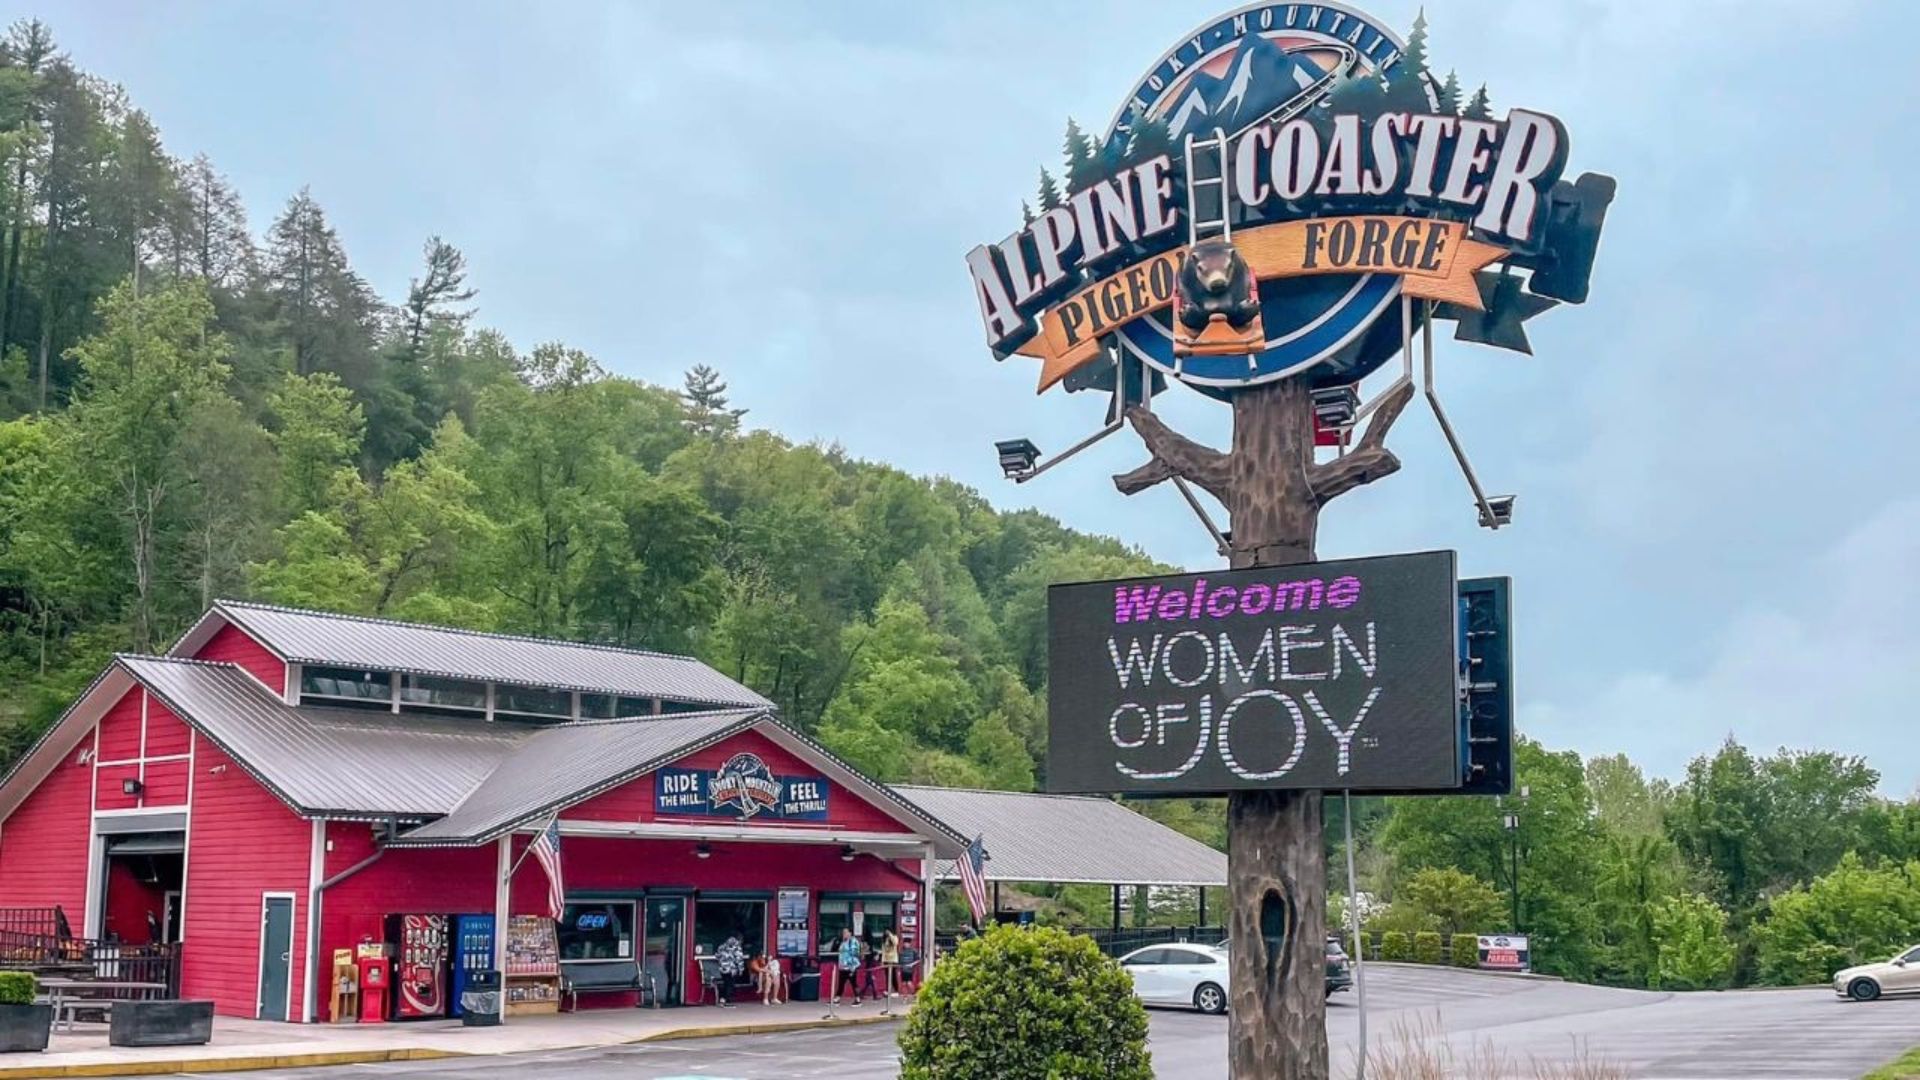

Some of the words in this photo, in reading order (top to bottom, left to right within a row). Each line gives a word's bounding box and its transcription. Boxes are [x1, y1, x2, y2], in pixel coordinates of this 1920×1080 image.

[1233, 5, 1401, 71] MOUNTAIN
[965, 153, 1180, 348] ALPINE
[1235, 108, 1559, 241] COASTER
[1056, 251, 1186, 347] PIGEO
[1301, 218, 1450, 271] FORGE
[1114, 575, 1361, 624] Welcome
[1107, 621, 1377, 689] WOMEN
[1109, 703, 1190, 748] OF
[1115, 687, 1383, 780] JOY
[659, 794, 678, 807] THE
[663, 773, 698, 793] RIDE
[790, 782, 819, 801] FEEL
[784, 802, 799, 814] THE
[579, 914, 607, 927] OPEN
